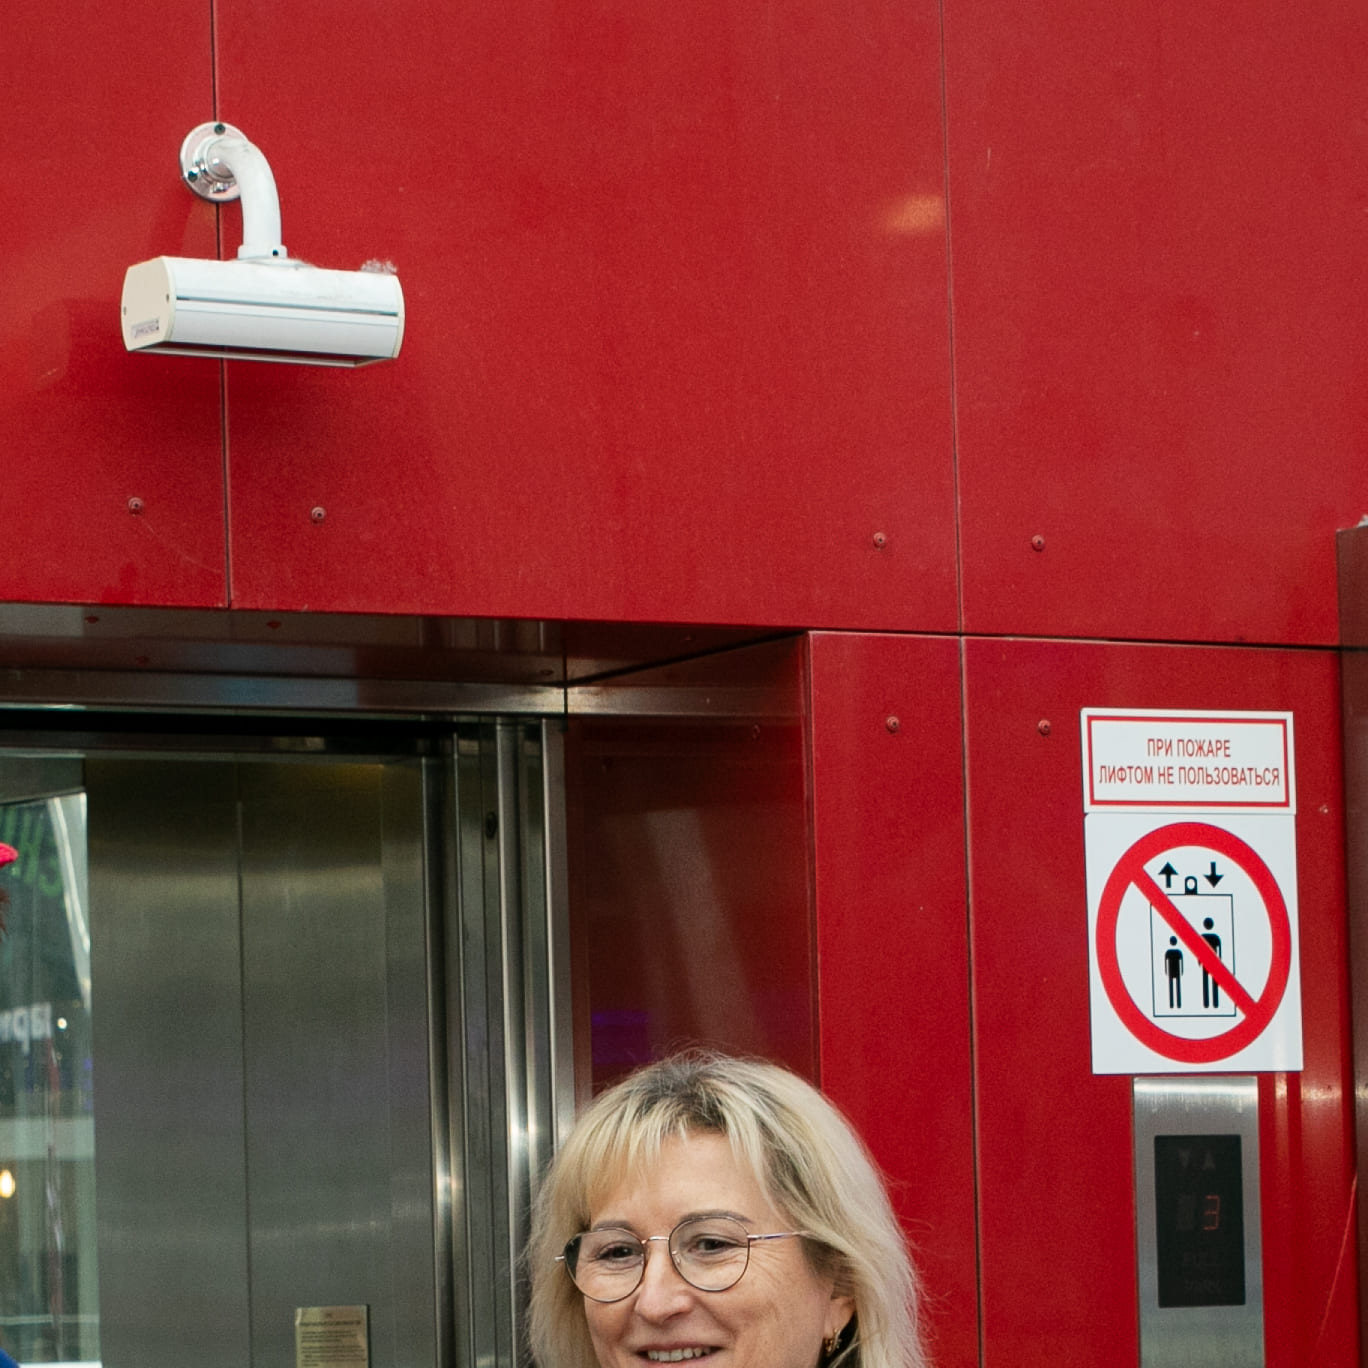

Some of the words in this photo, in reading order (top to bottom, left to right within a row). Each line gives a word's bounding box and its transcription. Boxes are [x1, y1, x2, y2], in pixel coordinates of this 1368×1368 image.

[1147, 738, 1172, 757] ПРИ
[1177, 739, 1231, 758] ПОЖАРЕ
[1099, 765, 1154, 785] ЛИФТОМ
[1158, 766, 1174, 785] НЕ
[1178, 766, 1280, 786] ПОЛЬЗОВАТЬСЯ
[1203, 1194, 1221, 1231] 3
